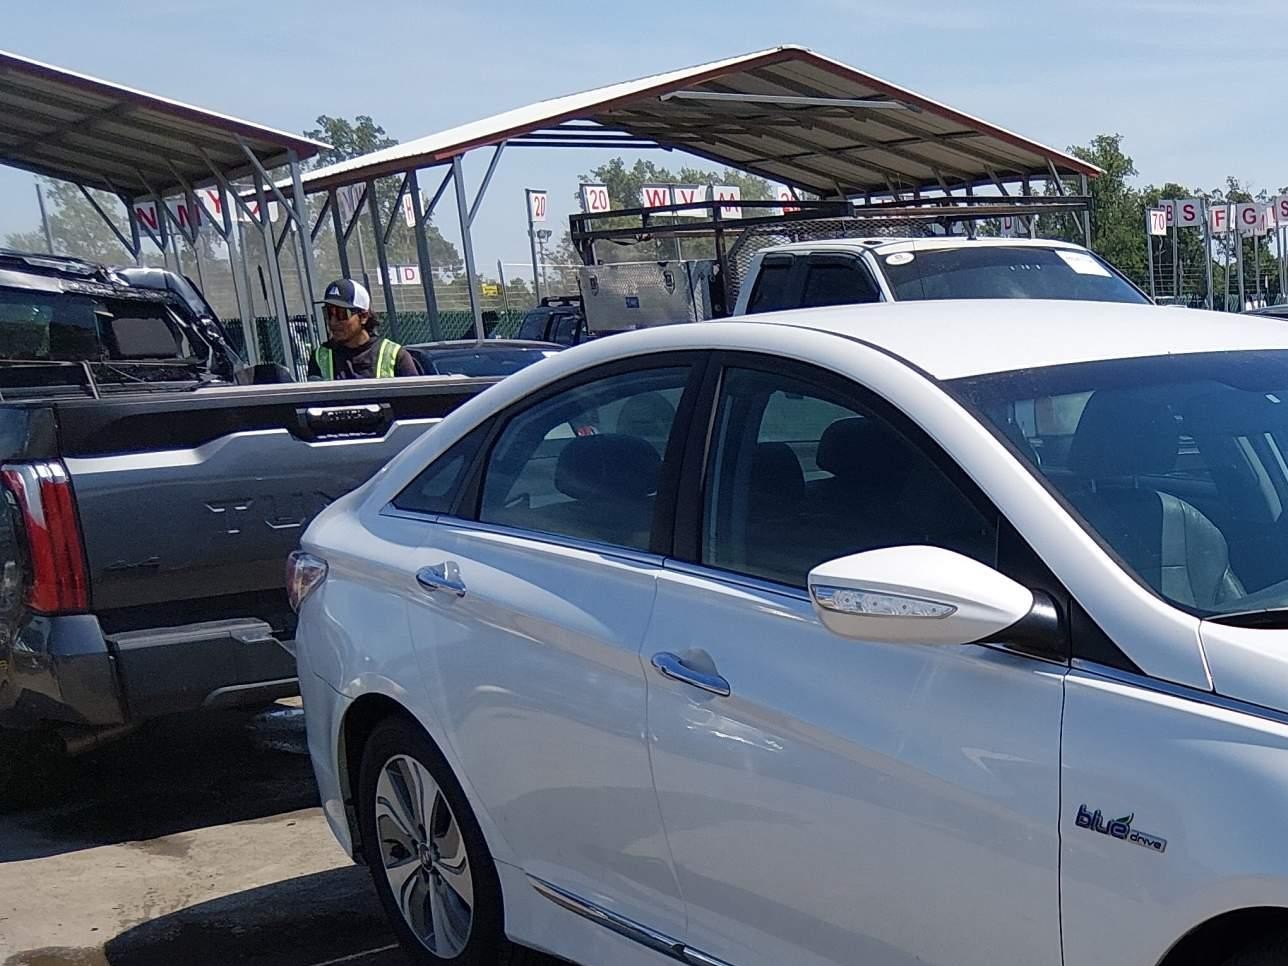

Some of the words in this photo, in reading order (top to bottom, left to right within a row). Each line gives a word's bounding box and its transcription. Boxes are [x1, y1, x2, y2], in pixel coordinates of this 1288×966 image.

[534, 196, 545, 216] 20
[590, 189, 607, 210] 20
[645, 189, 666, 208] W
[1152, 213, 1165, 230] 70
[1183, 204, 1196, 221] S
[1215, 210, 1226, 227] F
[1242, 207, 1257, 225] G
[404, 268, 416, 281] D
[1075, 804, 1131, 840] blue
